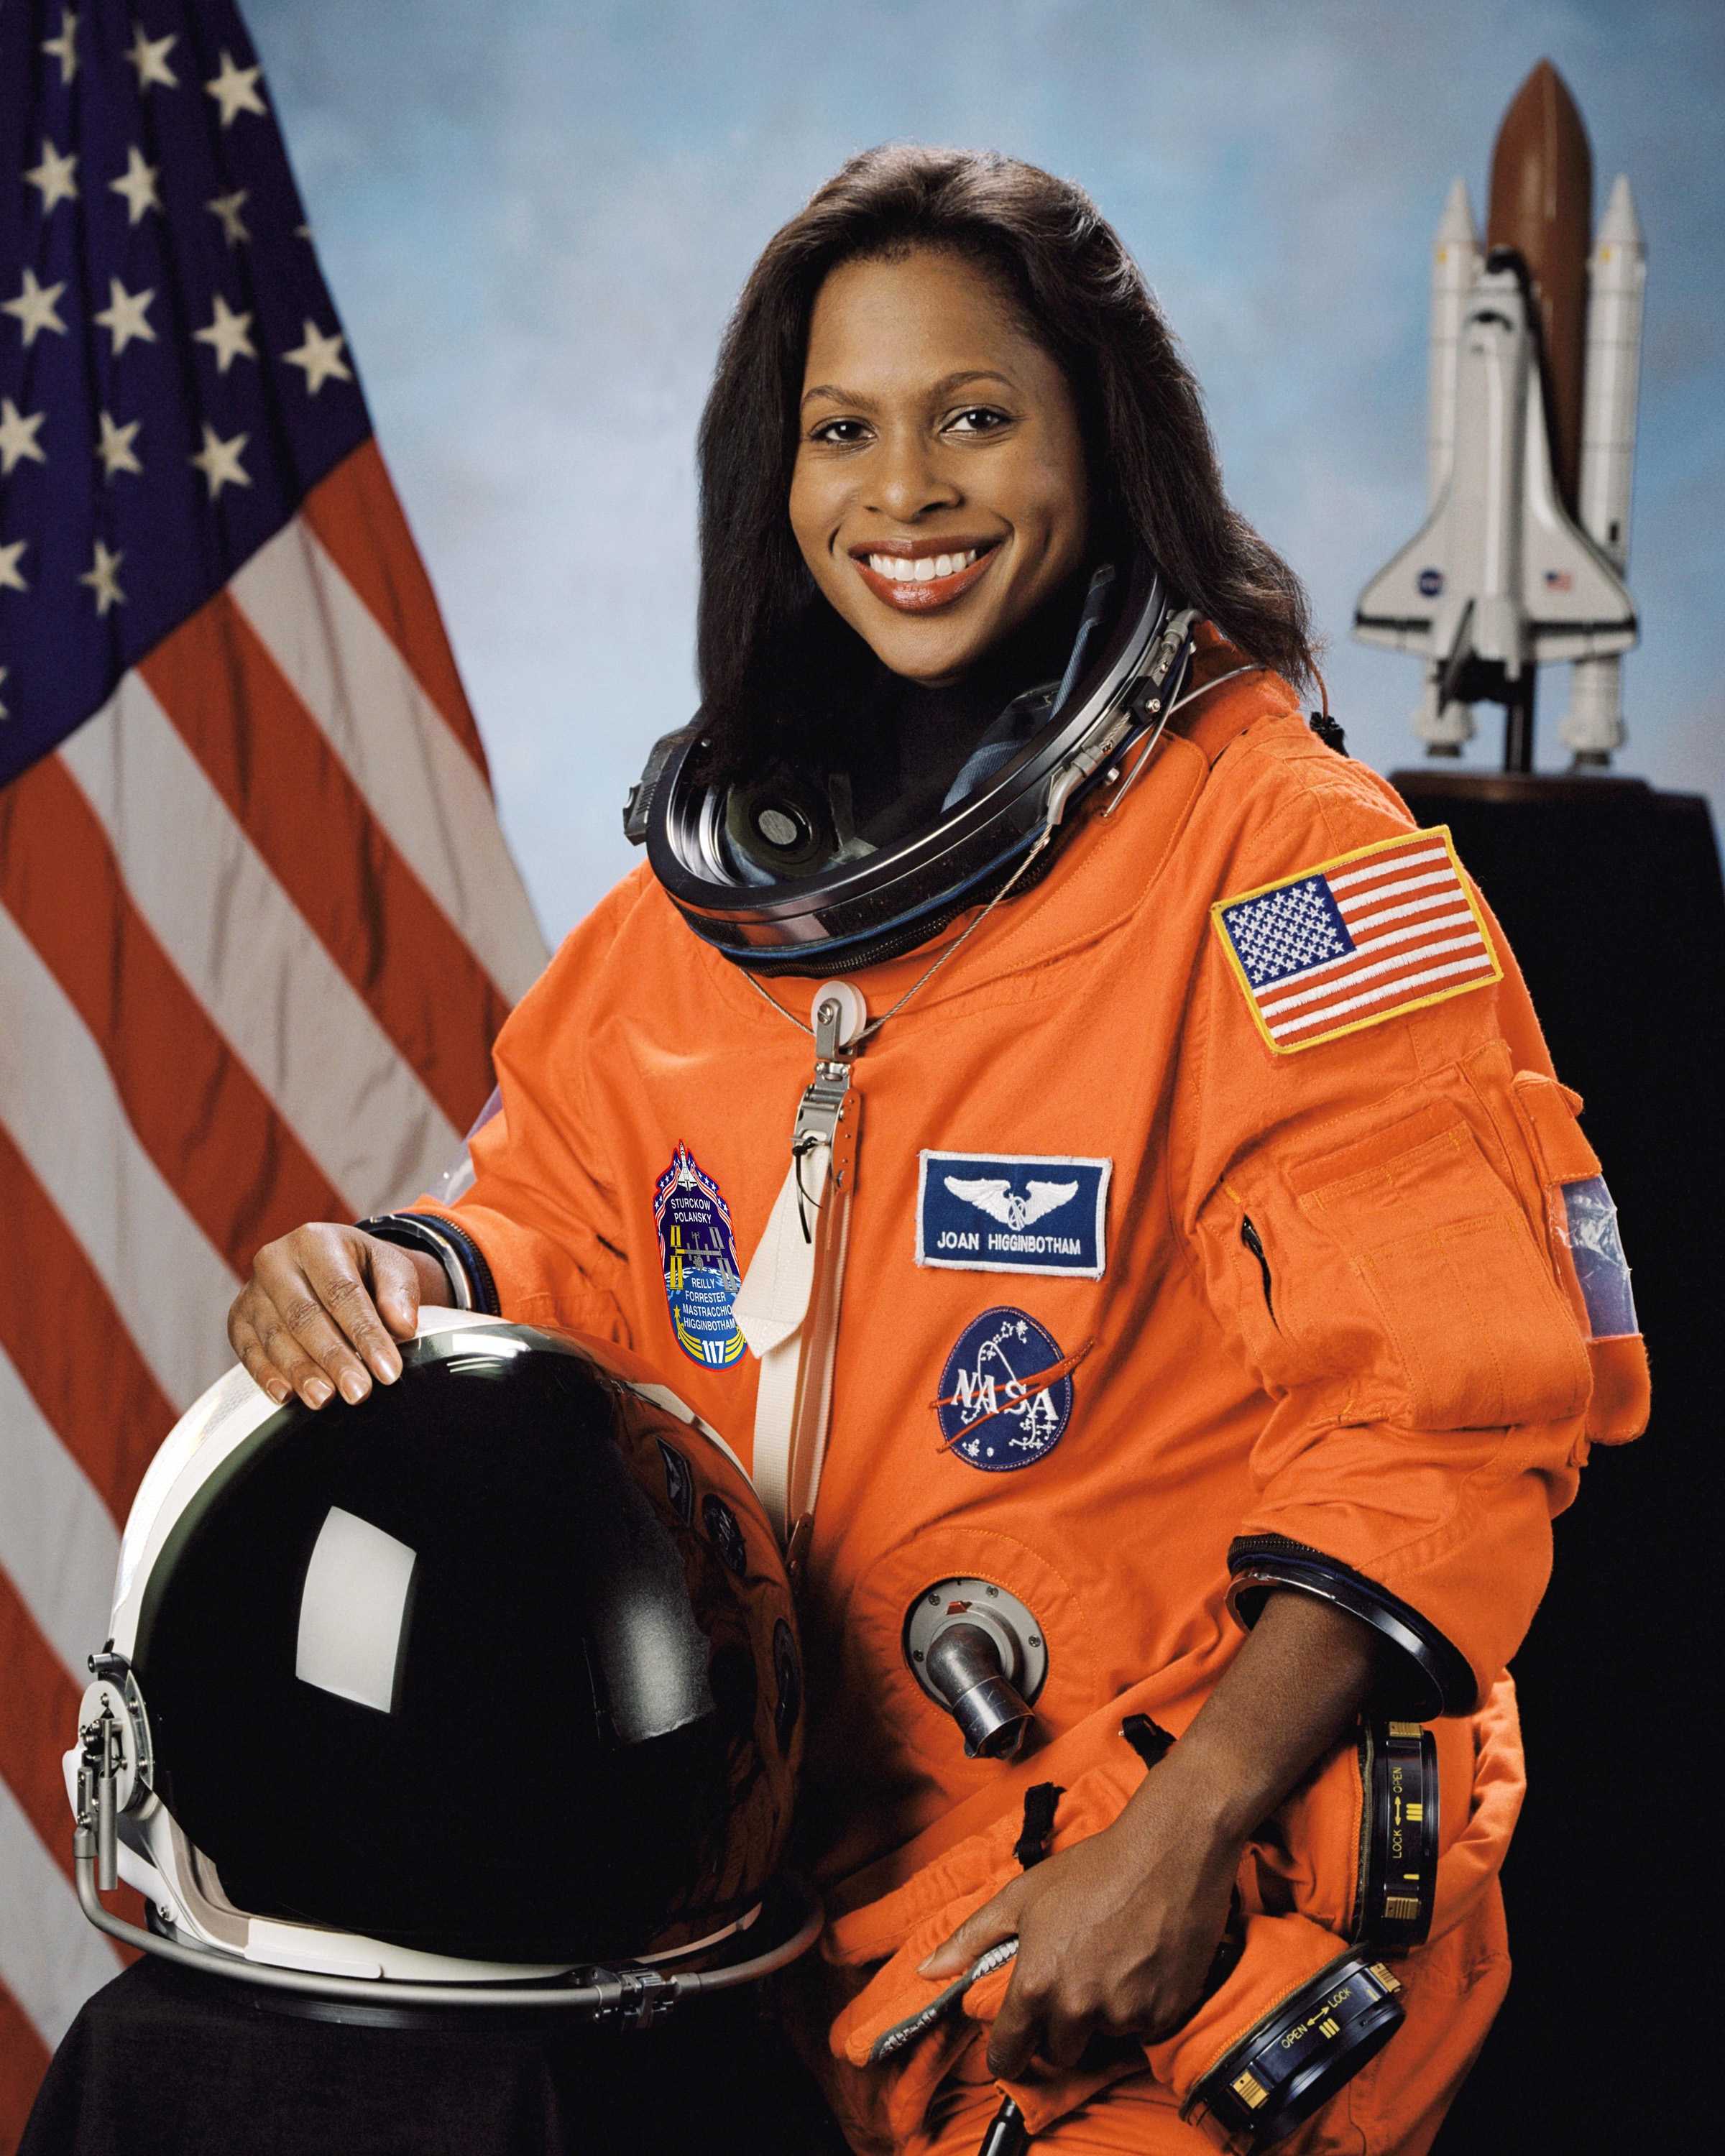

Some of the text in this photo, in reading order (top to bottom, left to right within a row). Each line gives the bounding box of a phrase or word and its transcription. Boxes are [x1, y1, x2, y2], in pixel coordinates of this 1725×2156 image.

[671, 1197, 710, 1210] STURCKOW
[674, 1212, 711, 1224] POLANSKY
[937, 1231, 1081, 1255] JOAN HIGGINBOTHAM
[692, 1278, 715, 1289] REILLY
[685, 1291, 726, 1303] FORRESTER
[683, 1304, 732, 1317] MASTRACCHIO
[684, 1317, 736, 1331] HIGGINBOTHAM
[702, 1340, 724, 1363] 117
[950, 1368, 1059, 1420] NASA
[1393, 1767, 1402, 1858] LOCK OPEN
[1282, 1989, 1352, 2048] OPEN LOCK
